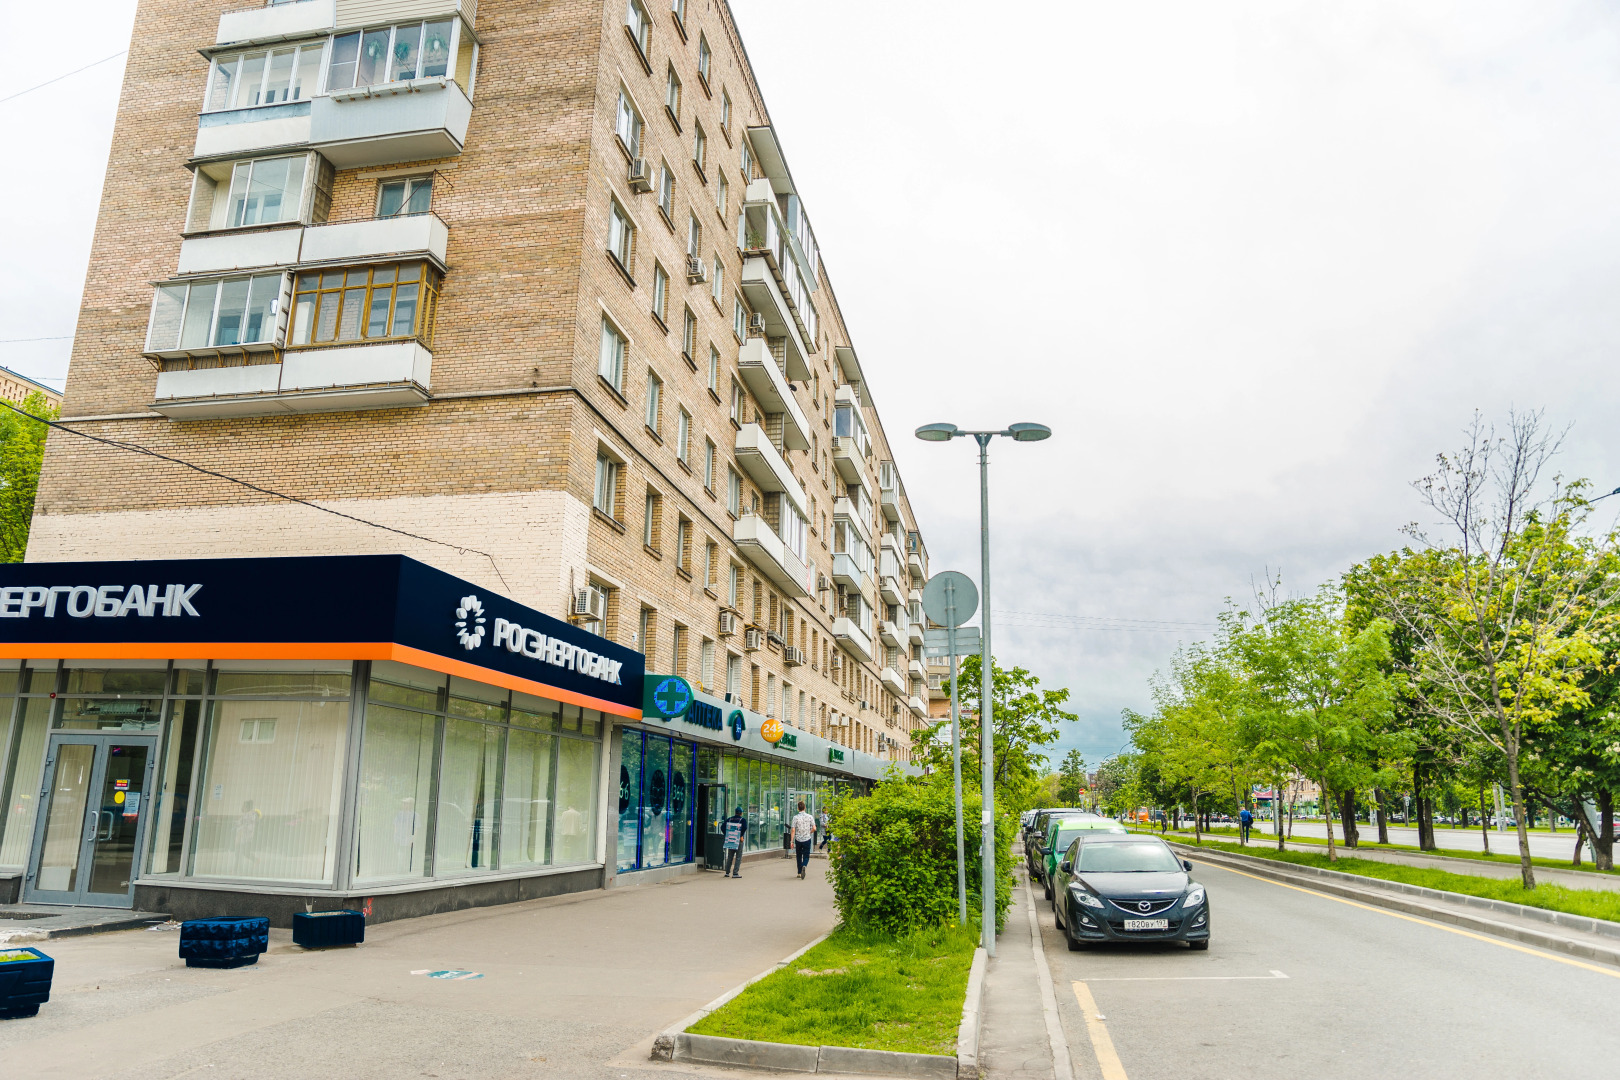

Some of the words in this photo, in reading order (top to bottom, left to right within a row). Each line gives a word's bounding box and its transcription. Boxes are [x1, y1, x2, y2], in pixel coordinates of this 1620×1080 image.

[0, 584, 203, 618] ЕРГОБАНК
[684, 700, 723, 731] АПТЕКА
[763, 723, 777, 733] 24
